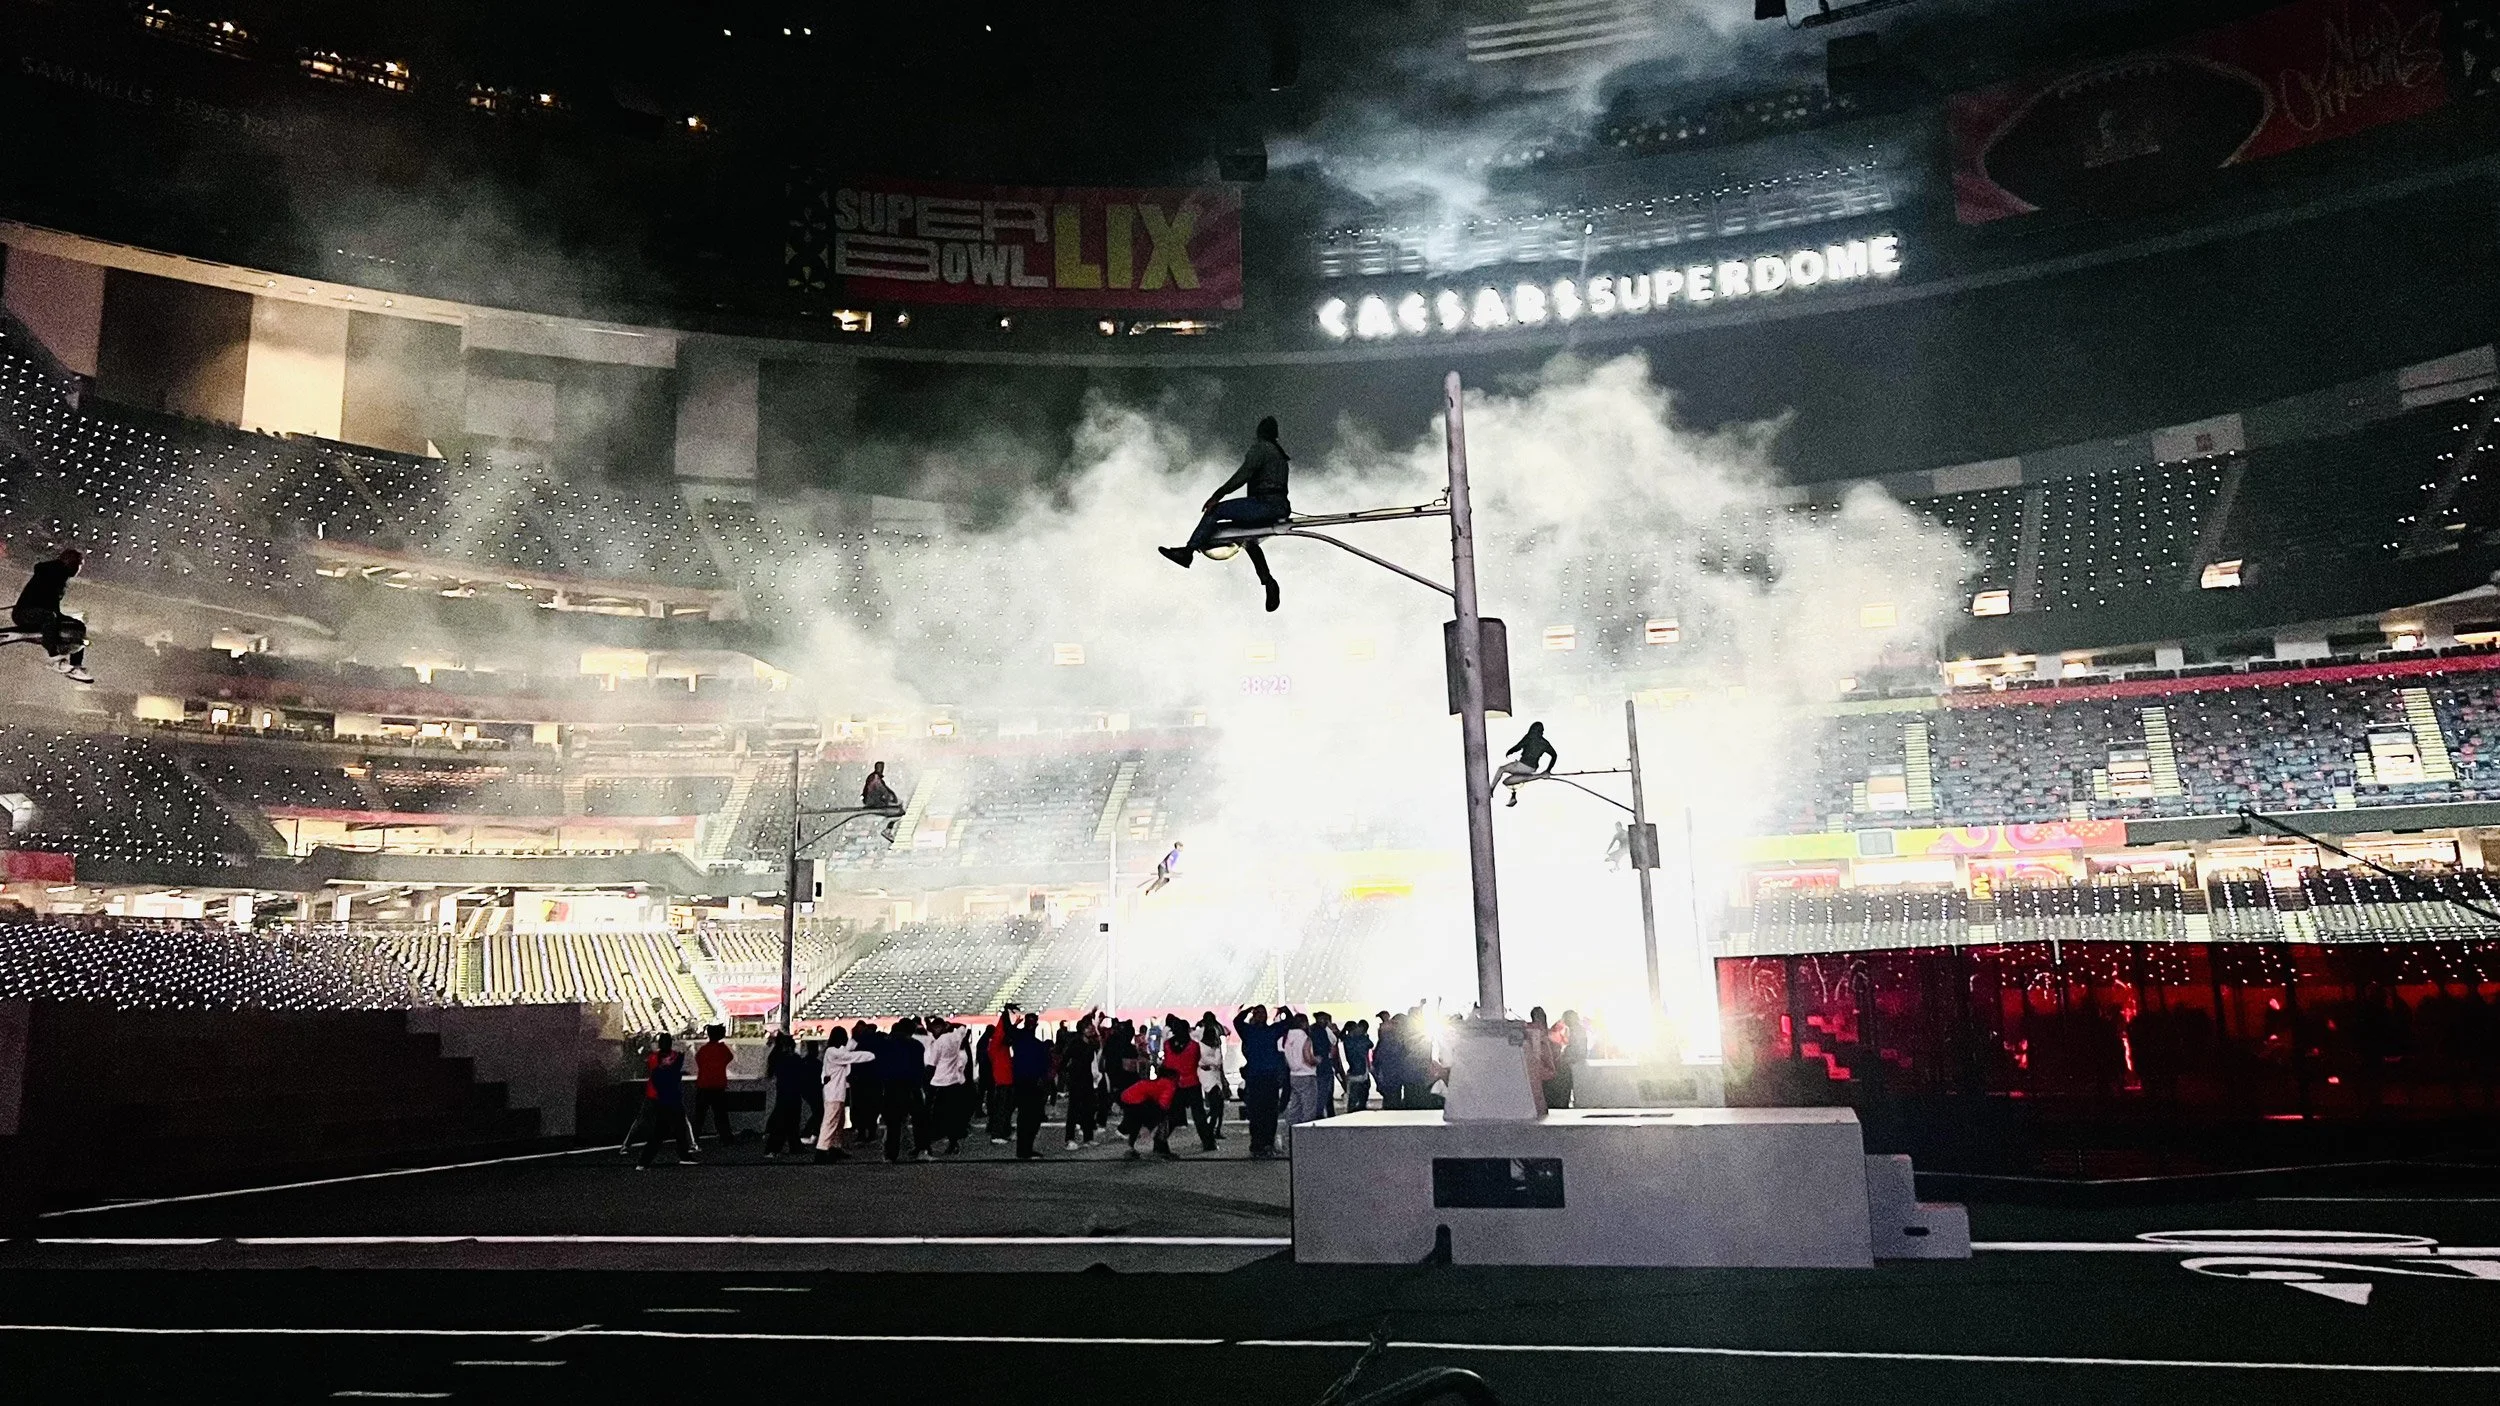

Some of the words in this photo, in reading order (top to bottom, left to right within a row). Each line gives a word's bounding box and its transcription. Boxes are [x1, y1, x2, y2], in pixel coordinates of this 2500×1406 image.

[20, 55, 75, 87] SAM
[82, 72, 154, 106] MILLS
[834, 187, 1049, 243] SUPER
[835, 232, 1049, 289] BOWL
[1054, 201, 1202, 291] LIX
[1317, 277, 1583, 340] CAESARS
[1587, 233, 1903, 315] SUPERDOME
